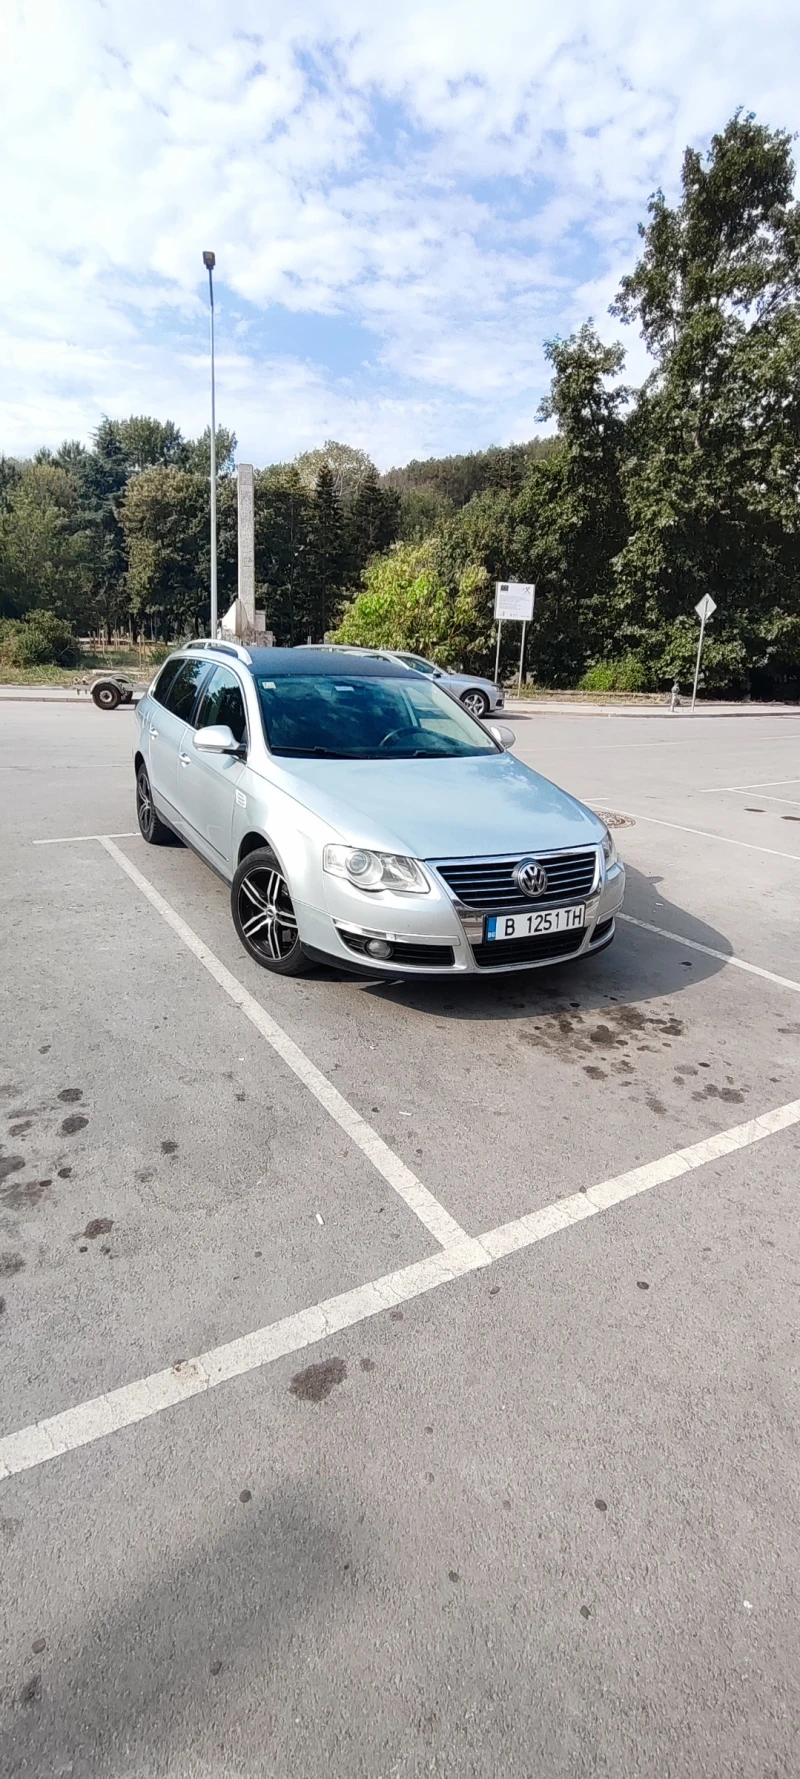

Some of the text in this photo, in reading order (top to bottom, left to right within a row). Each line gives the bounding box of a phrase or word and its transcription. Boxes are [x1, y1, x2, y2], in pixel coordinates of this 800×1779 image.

[504, 908, 582, 936] B 1251 TH
